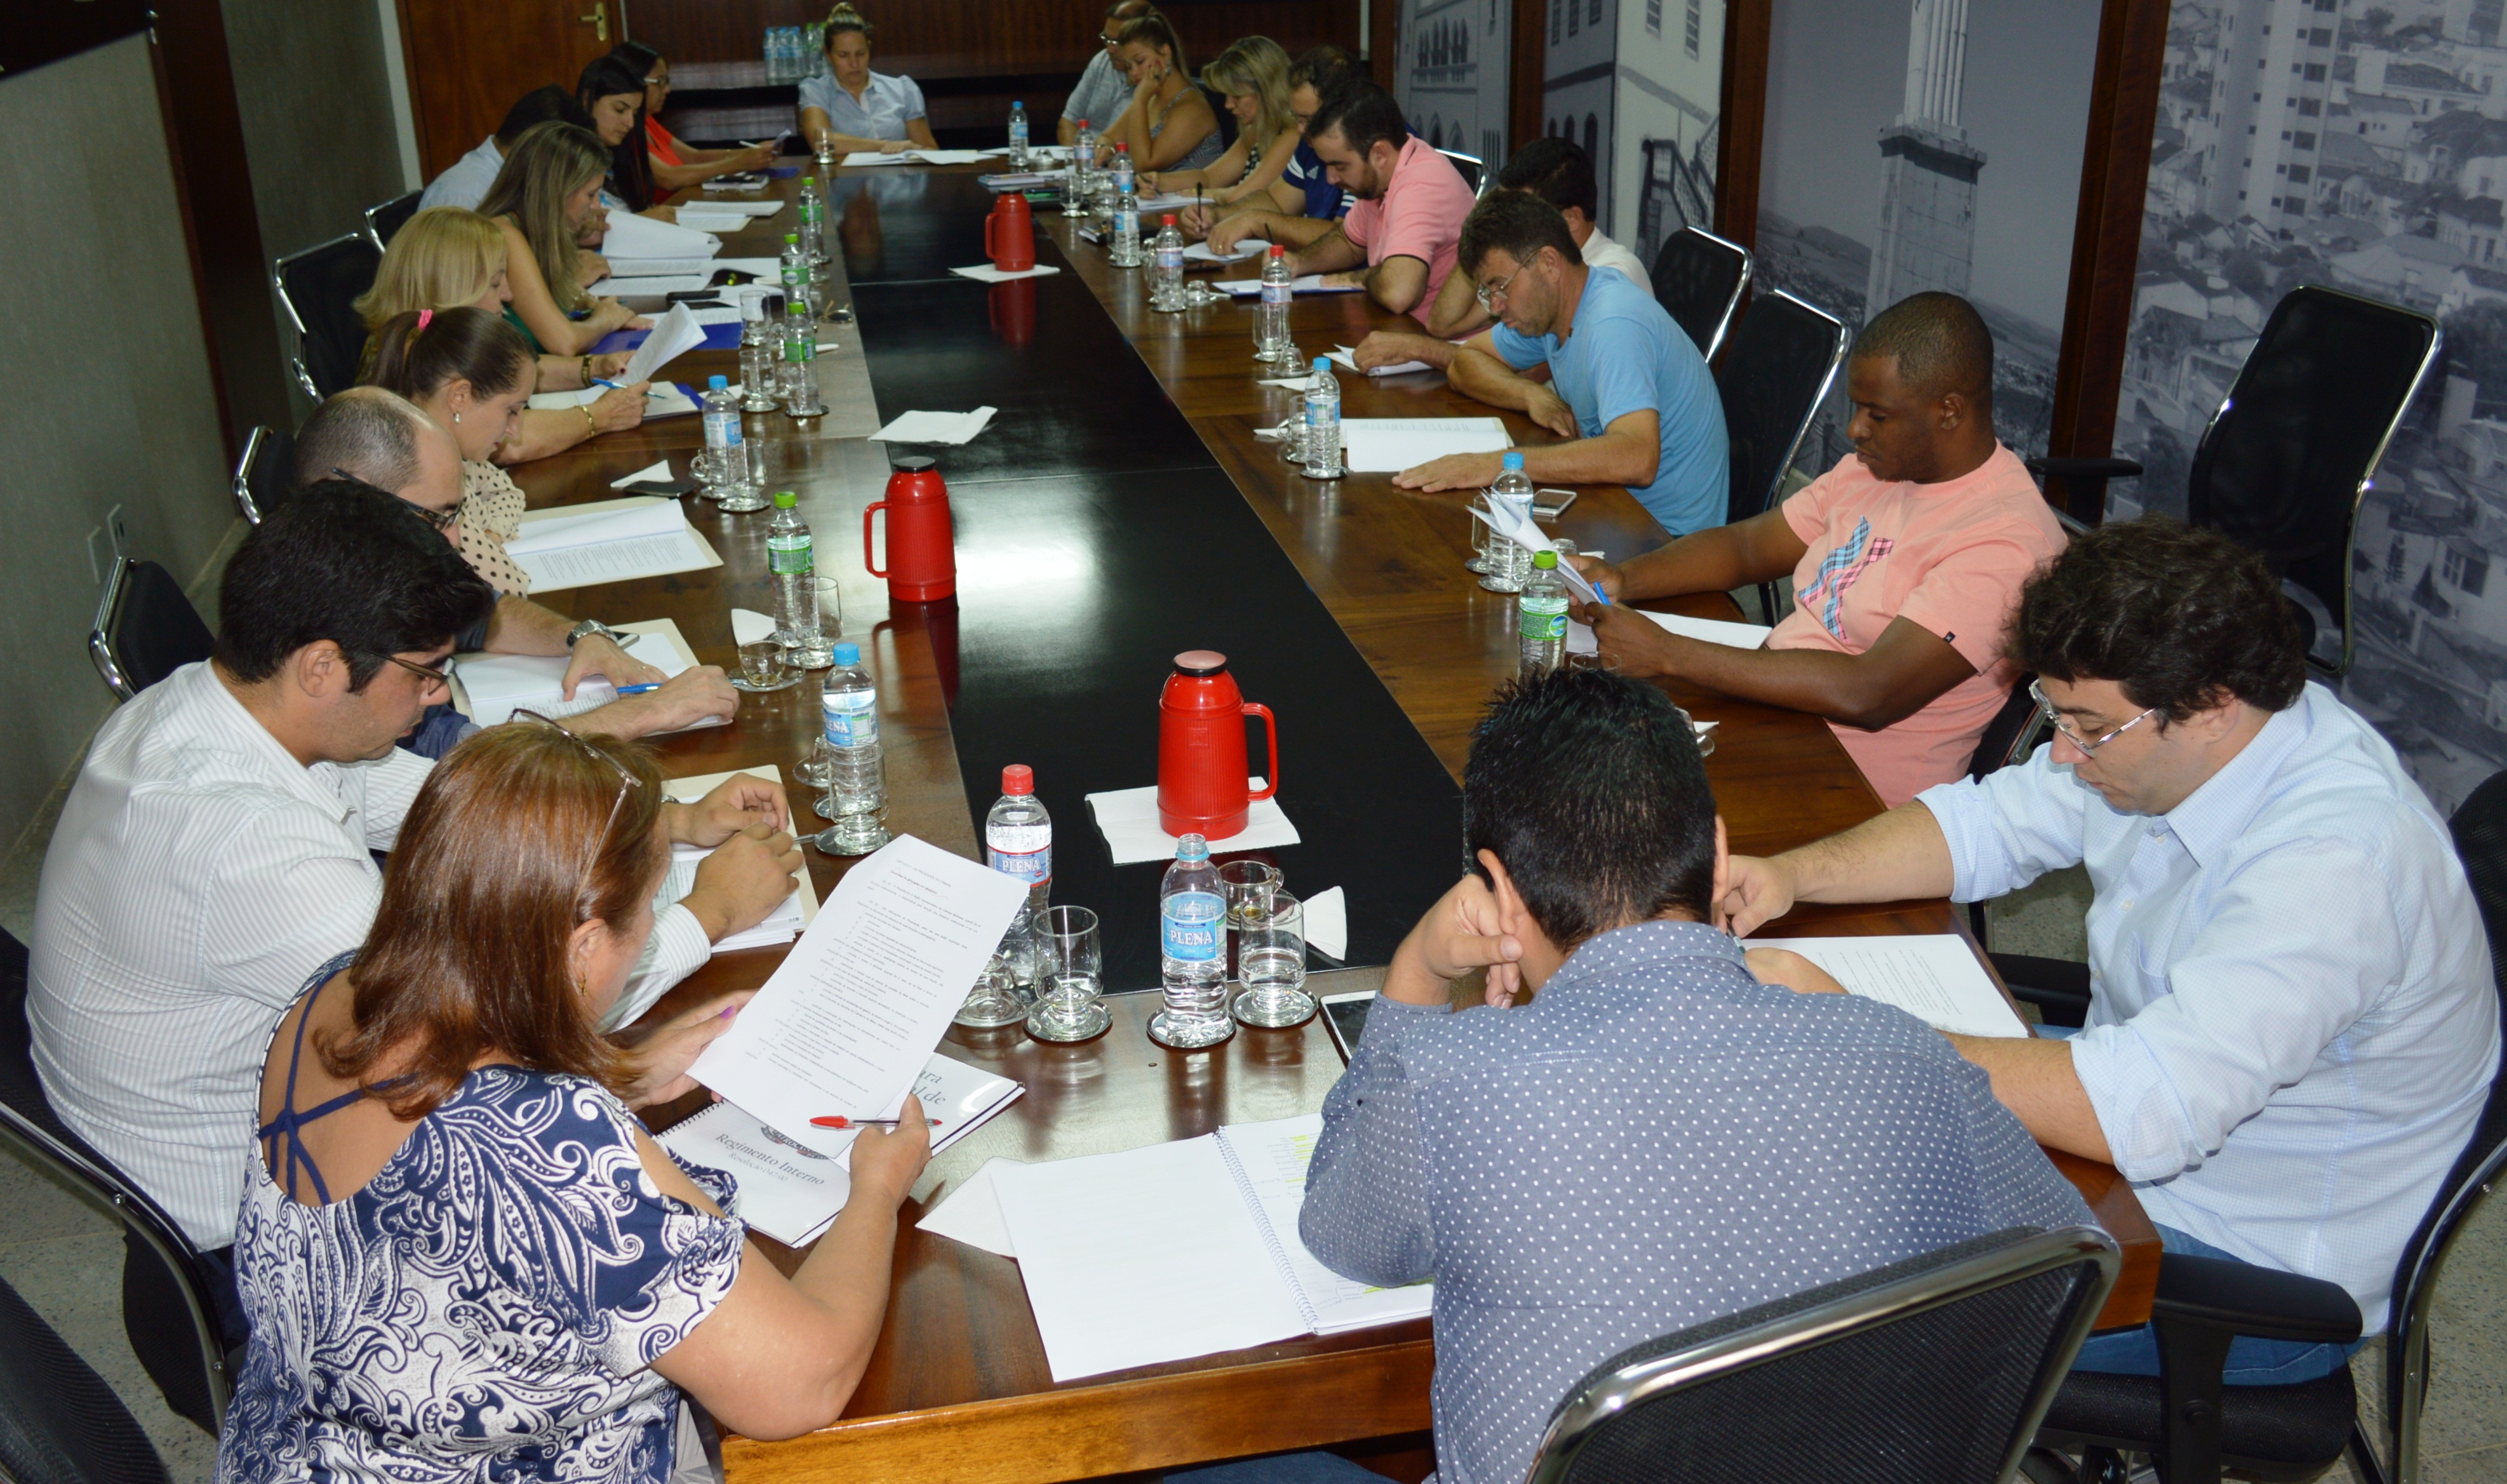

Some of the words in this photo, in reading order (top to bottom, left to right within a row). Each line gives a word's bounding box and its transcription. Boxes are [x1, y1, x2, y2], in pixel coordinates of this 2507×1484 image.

[1002, 858, 1041, 873] PLENA
[1170, 929, 1213, 945] PLENA
[923, 1092, 946, 1105] de
[716, 1133, 779, 1166] Regimento
[779, 1161, 825, 1186] Interno
